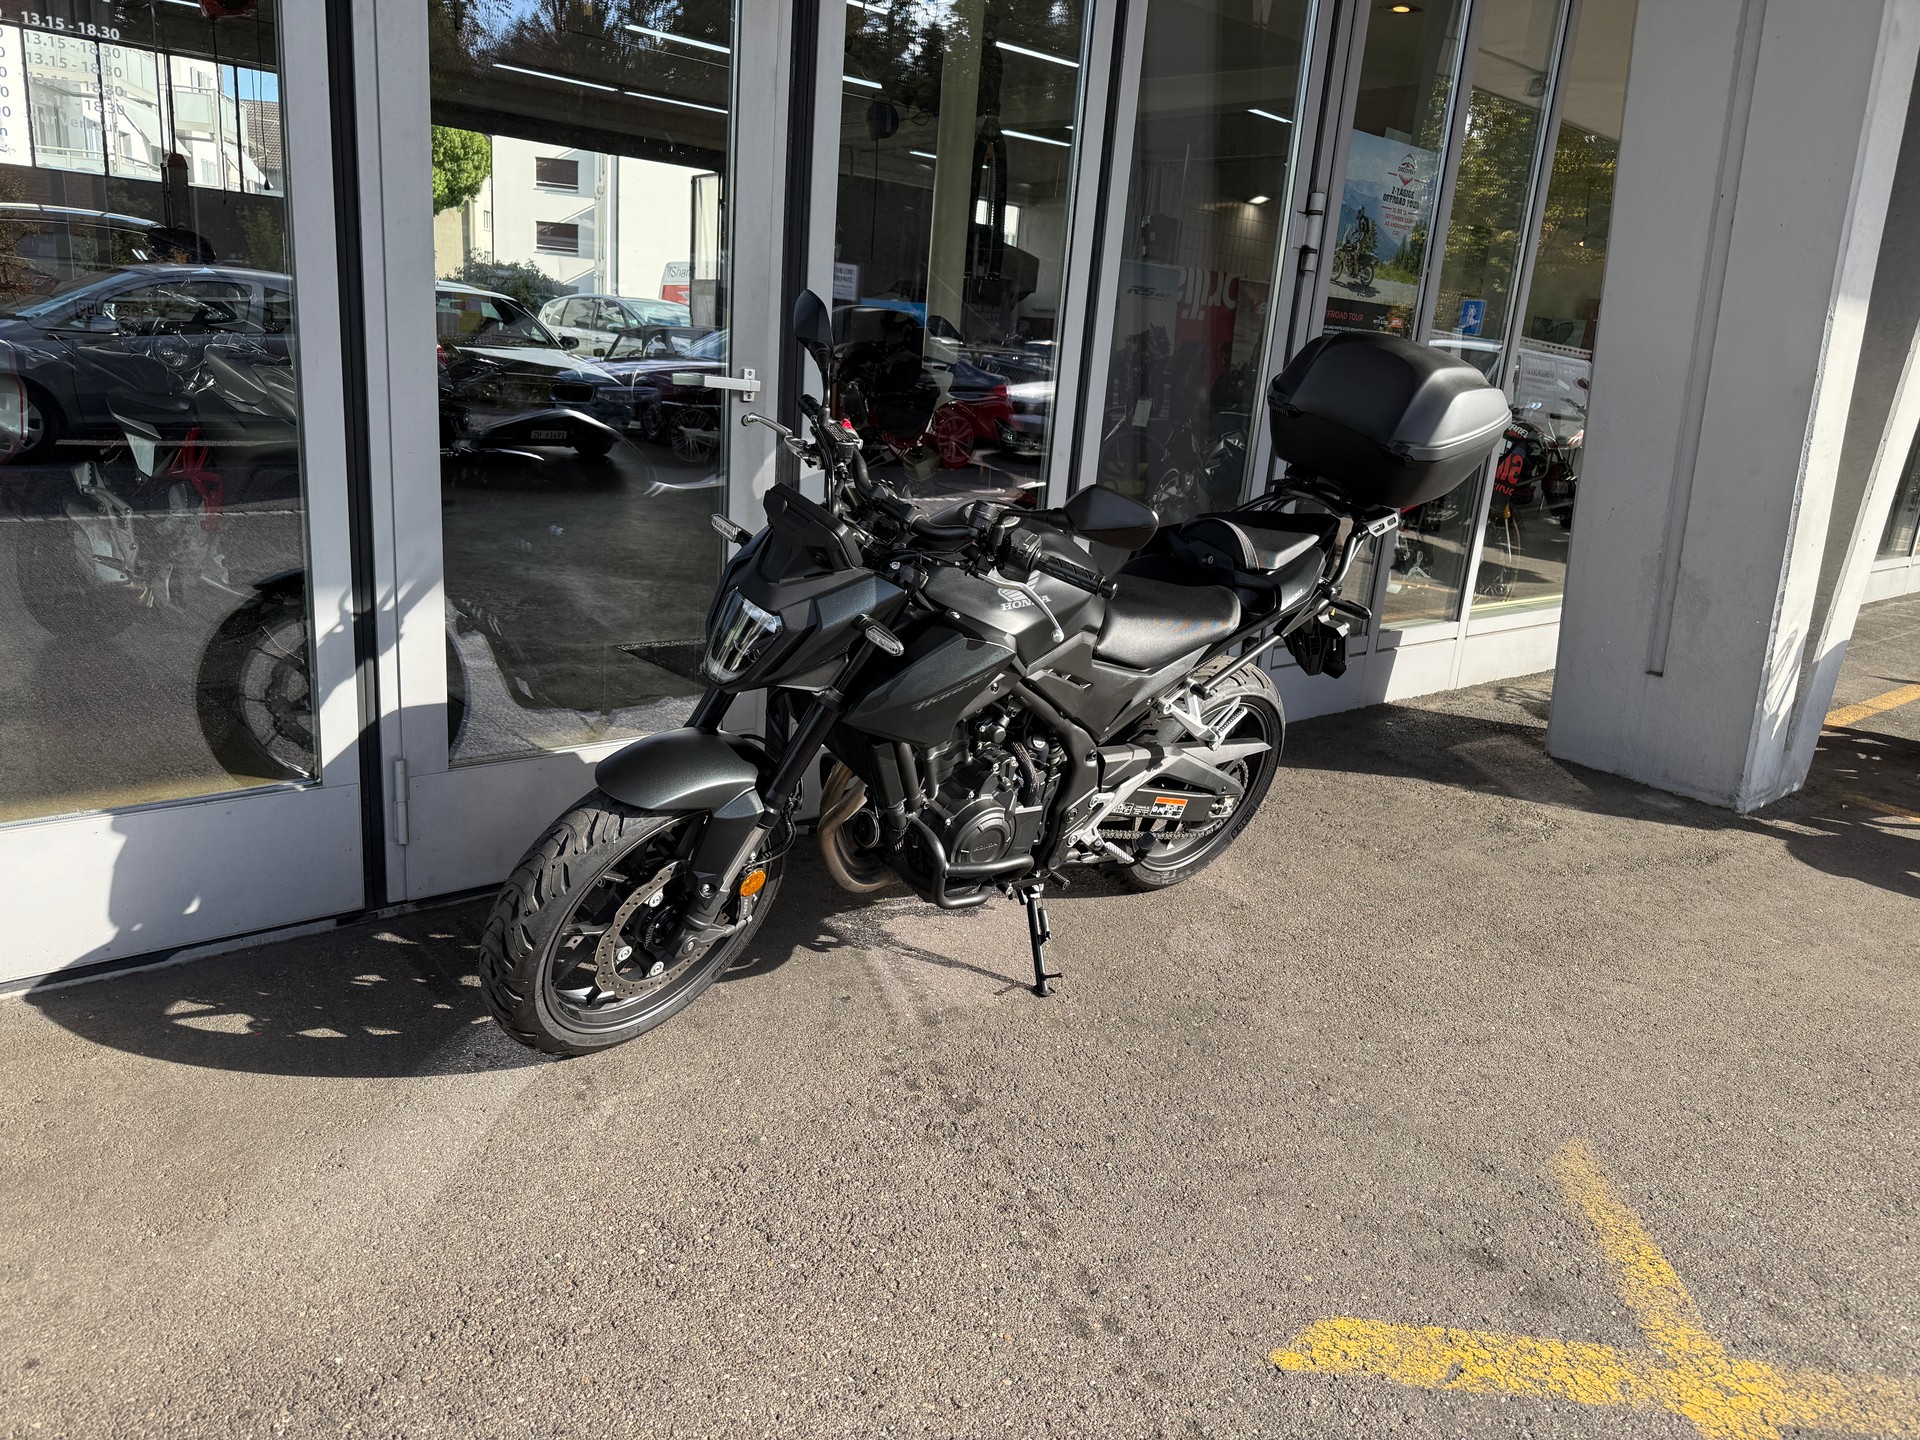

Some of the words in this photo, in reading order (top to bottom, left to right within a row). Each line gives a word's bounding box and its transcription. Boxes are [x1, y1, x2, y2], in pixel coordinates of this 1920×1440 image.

[21, 11, 65, 30] 13.15
[78, 22, 120, 40] 18.30
[25, 32, 66, 49] 13.15
[80, 42, 121, 58] 18.30
[27, 52, 68, 69] 13.15
[82, 61, 122, 78] 18.30
[85, 100, 125, 115] 18.30
[1382, 193, 1406, 206] OFFROAD
[1406, 199, 1420, 210] TOUR
[1126, 285, 1157, 296] RS
[1348, 312, 1364, 321] TOUR
[1001, 595, 1051, 611] HONA
[1237, 806, 1255, 830] ROAD
